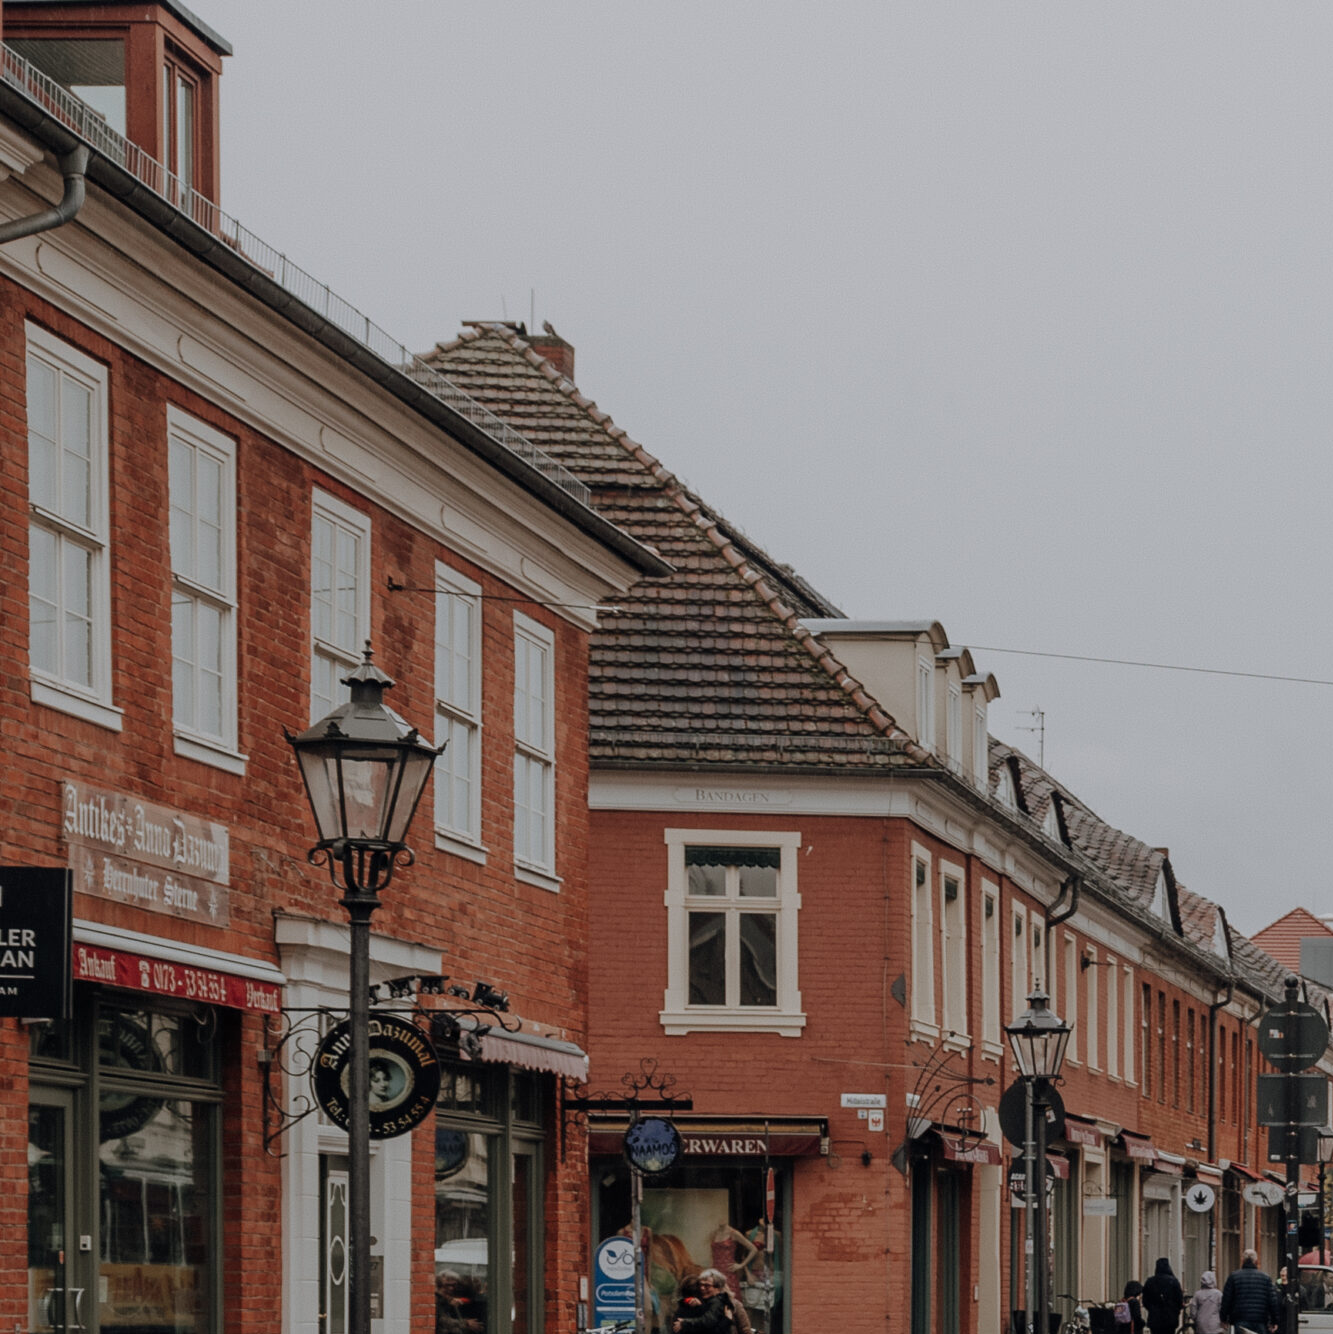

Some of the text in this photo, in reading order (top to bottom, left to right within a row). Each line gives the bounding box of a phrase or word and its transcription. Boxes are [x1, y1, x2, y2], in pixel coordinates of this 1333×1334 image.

[79, 948, 116, 980] Ankauf
[246, 981, 279, 1013] Verkauf
[320, 1020, 436, 1070] Ann Dazumal
